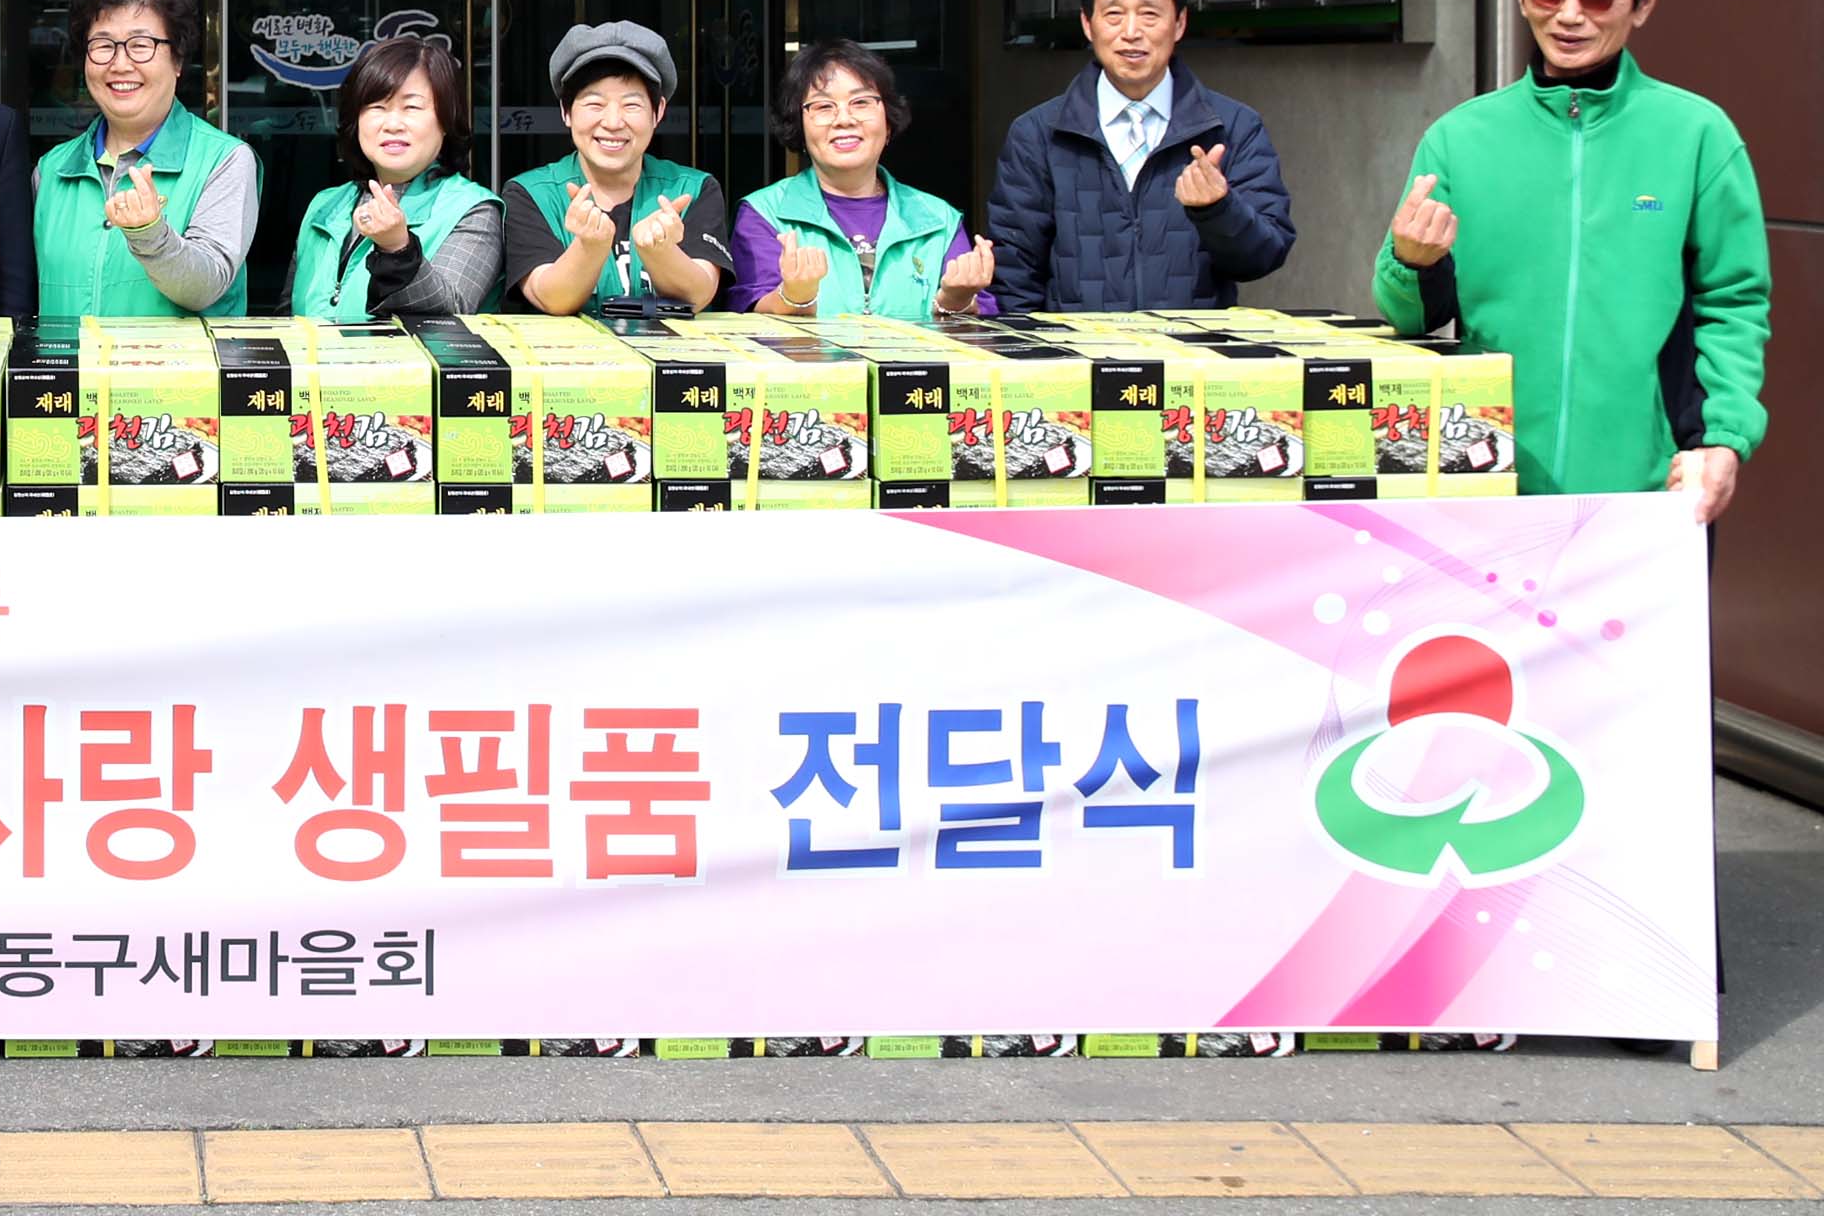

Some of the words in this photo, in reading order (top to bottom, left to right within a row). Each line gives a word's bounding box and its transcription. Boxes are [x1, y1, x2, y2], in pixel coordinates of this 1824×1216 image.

[254, 16, 293, 38] 새로운
[296, 14, 332, 36] 변화
[277, 39, 313, 61] 모두가
[318, 36, 357, 59] 행복한
[681, 386, 719, 409] 재래
[905, 387, 943, 410] 재래
[956, 387, 980, 401] 백제
[1120, 384, 1157, 406] 재래
[1328, 383, 1366, 406] 재래
[1379, 383, 1403, 395] 백제
[34, 391, 72, 414] 재래
[247, 390, 285, 412] 재래
[467, 391, 505, 413] 재래
[271, 701, 712, 882] 생필품
[770, 698, 1201, 872] 전달식
